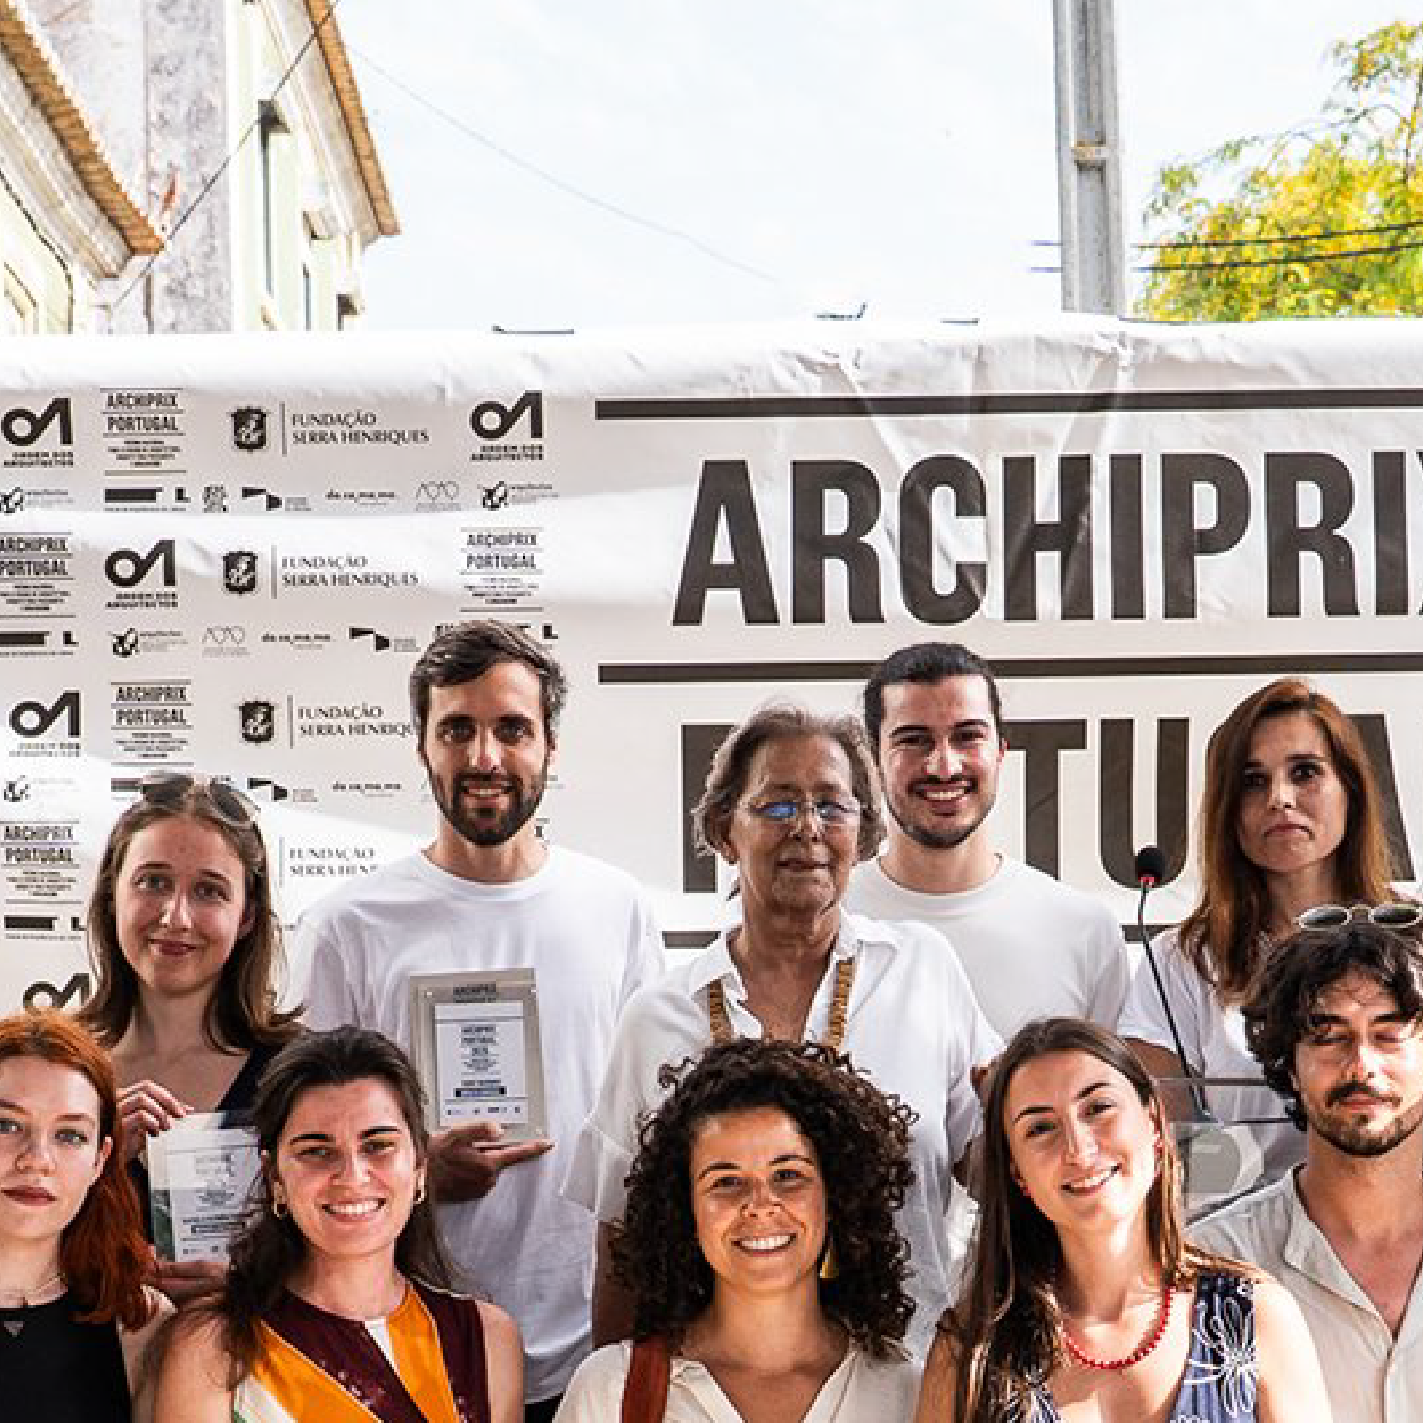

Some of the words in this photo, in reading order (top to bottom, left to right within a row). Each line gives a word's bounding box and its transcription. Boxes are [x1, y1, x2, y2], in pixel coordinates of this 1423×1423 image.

[107, 394, 178, 408] ARCHIPRIX
[108, 416, 178, 431] PORTUGAL
[116, 686, 186, 702] ARCHIPRIX
[116, 709, 186, 725] PORTUGAL
[4, 826, 73, 840] ARCHIPRIX
[6, 848, 73, 863] PORTUGAL
